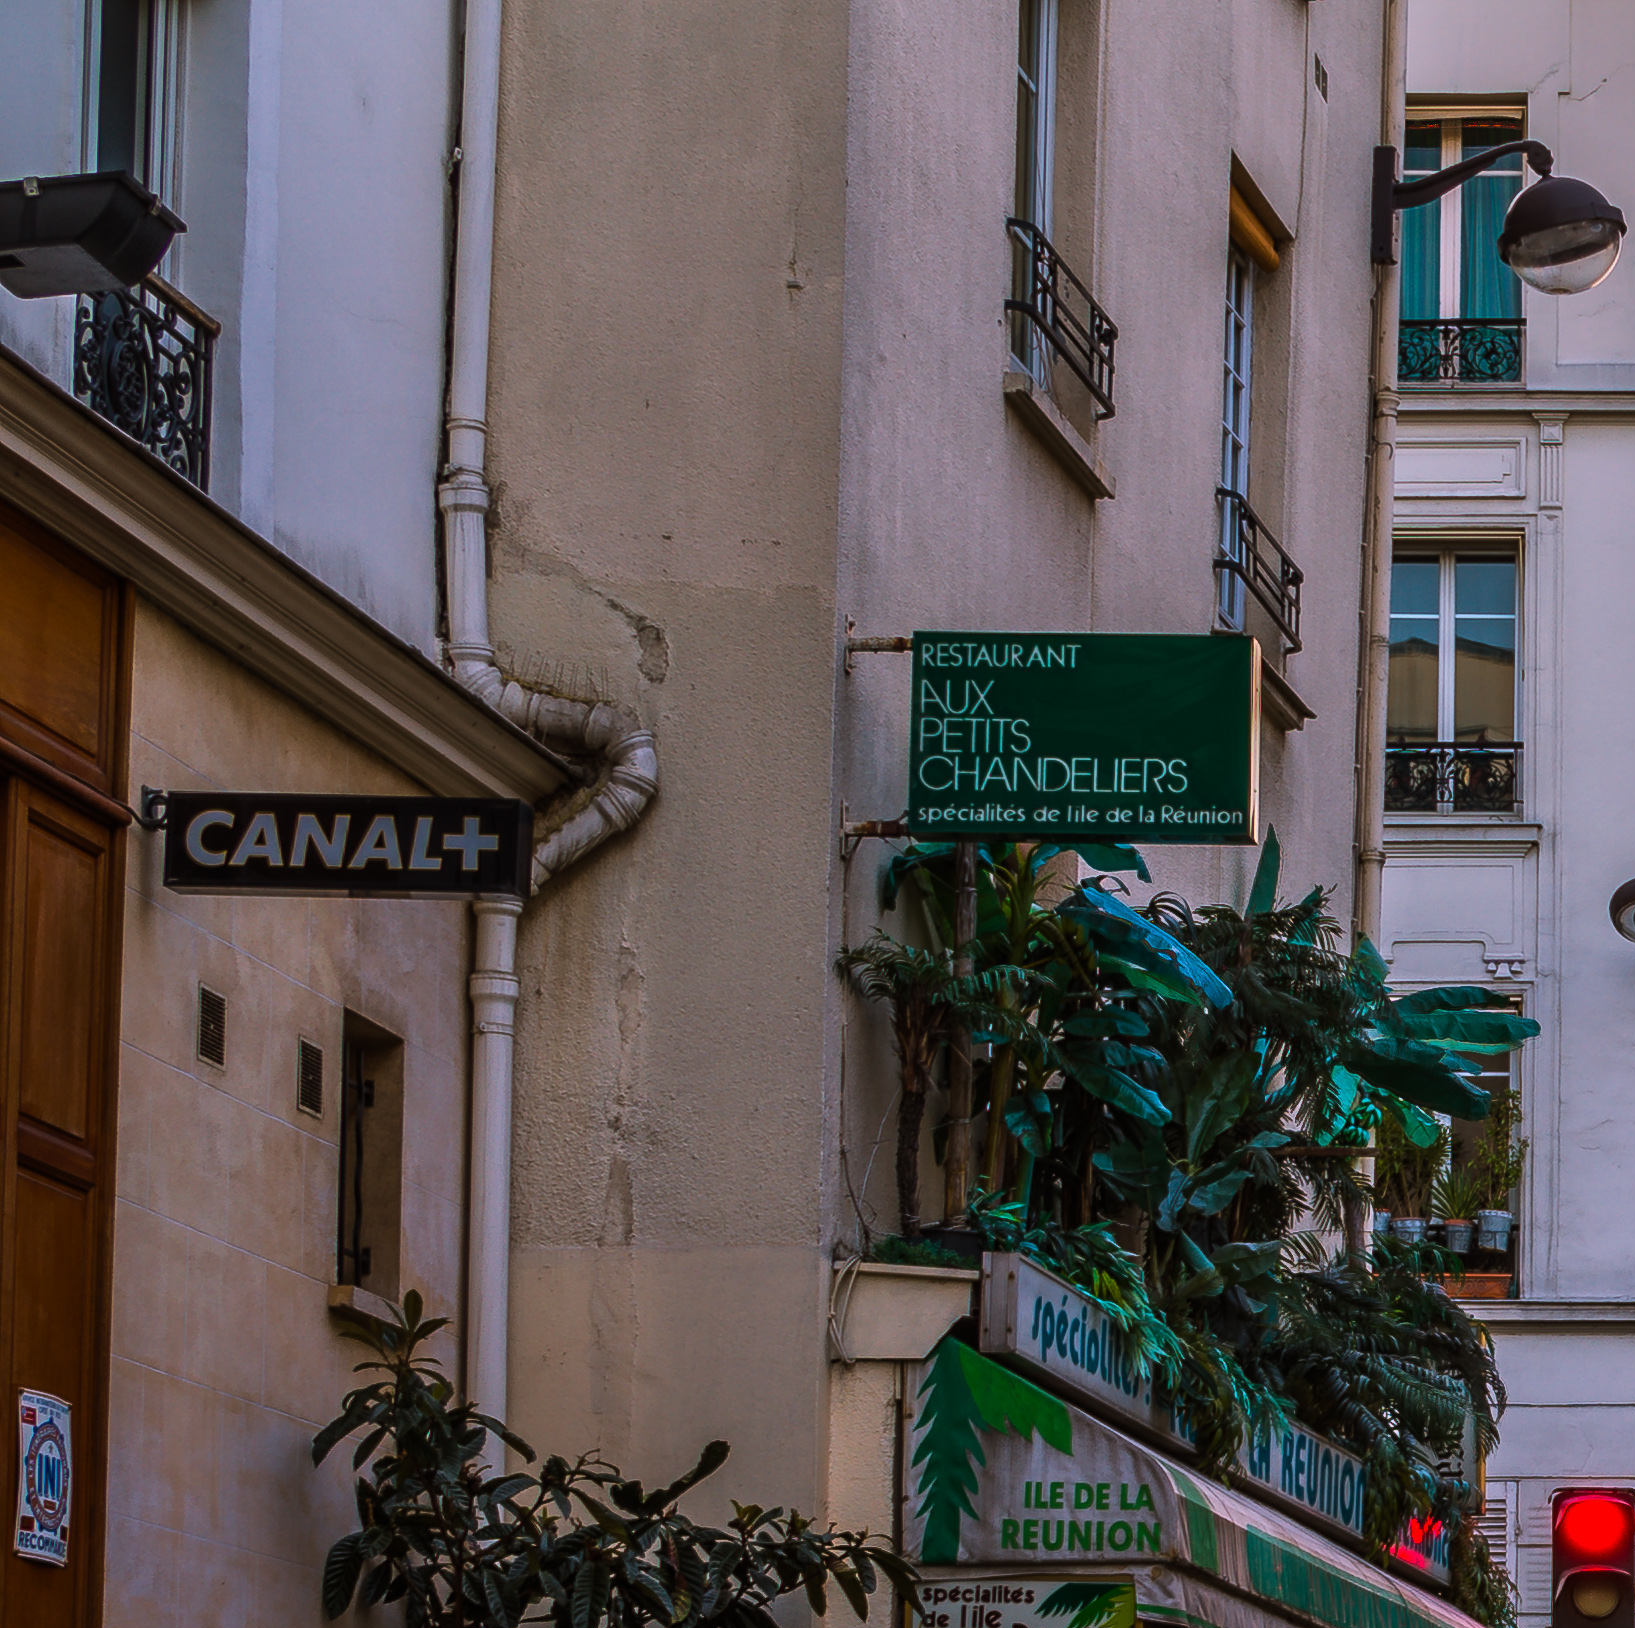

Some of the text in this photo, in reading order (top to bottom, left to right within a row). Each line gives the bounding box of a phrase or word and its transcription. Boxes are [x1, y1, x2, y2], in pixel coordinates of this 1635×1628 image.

[921, 643, 1082, 668] RESTAURANT
[920, 679, 995, 716] AUX
[919, 717, 1032, 754] PETITS
[918, 755, 1189, 794] CHANDELIERS
[917, 802, 1026, 824] spécialités
[1033, 804, 1061, 823] de
[1106, 804, 1134, 823] de
[1139, 804, 1155, 823] la
[1161, 804, 1244, 825] Réunion
[184, 808, 500, 872] CANAL+
[1024, 1481, 1155, 1511] ILE DE LA
[1002, 1518, 1162, 1552] REUNION
[922, 1585, 1035, 1605] spécialités
[922, 1610, 949, 1628] de
